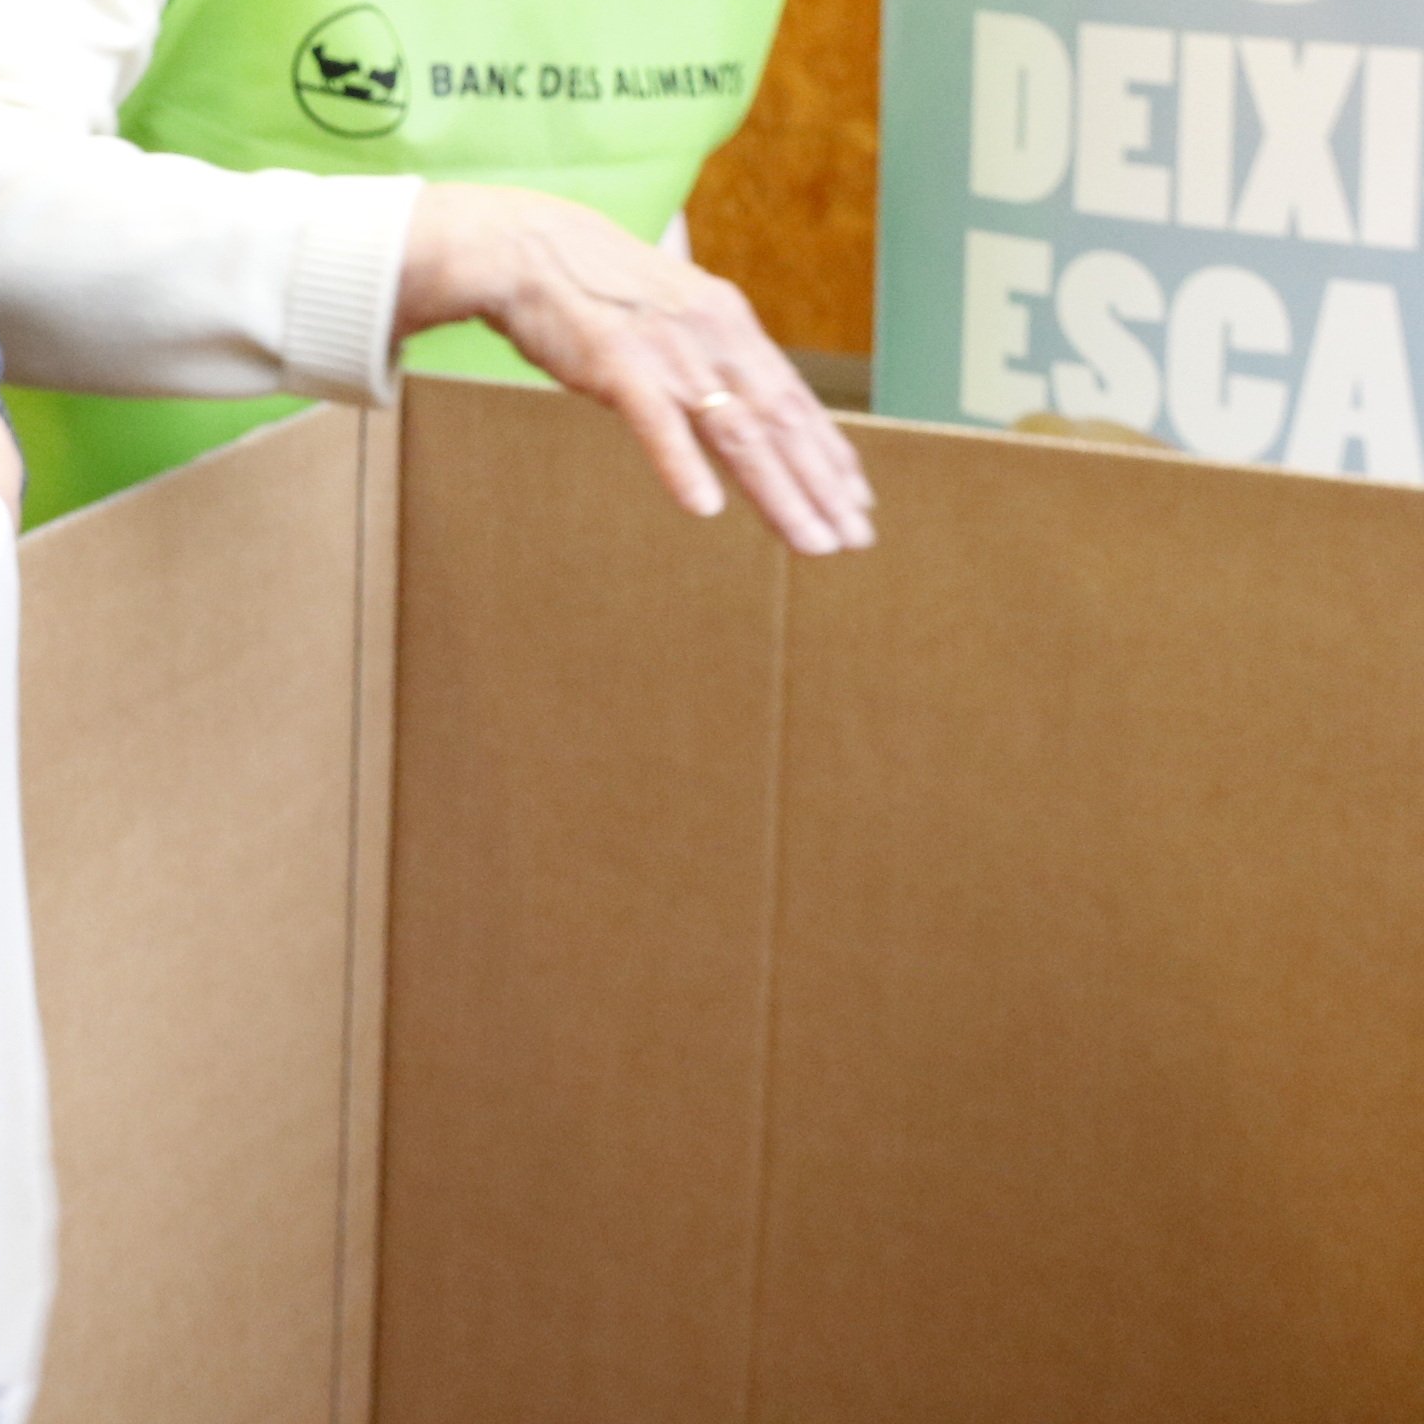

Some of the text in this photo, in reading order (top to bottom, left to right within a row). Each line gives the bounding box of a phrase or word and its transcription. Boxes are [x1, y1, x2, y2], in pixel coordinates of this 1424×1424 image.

[431, 64, 526, 99] BANC
[968, 9, 1424, 251] DEIXI
[960, 228, 1424, 486] ESCA
